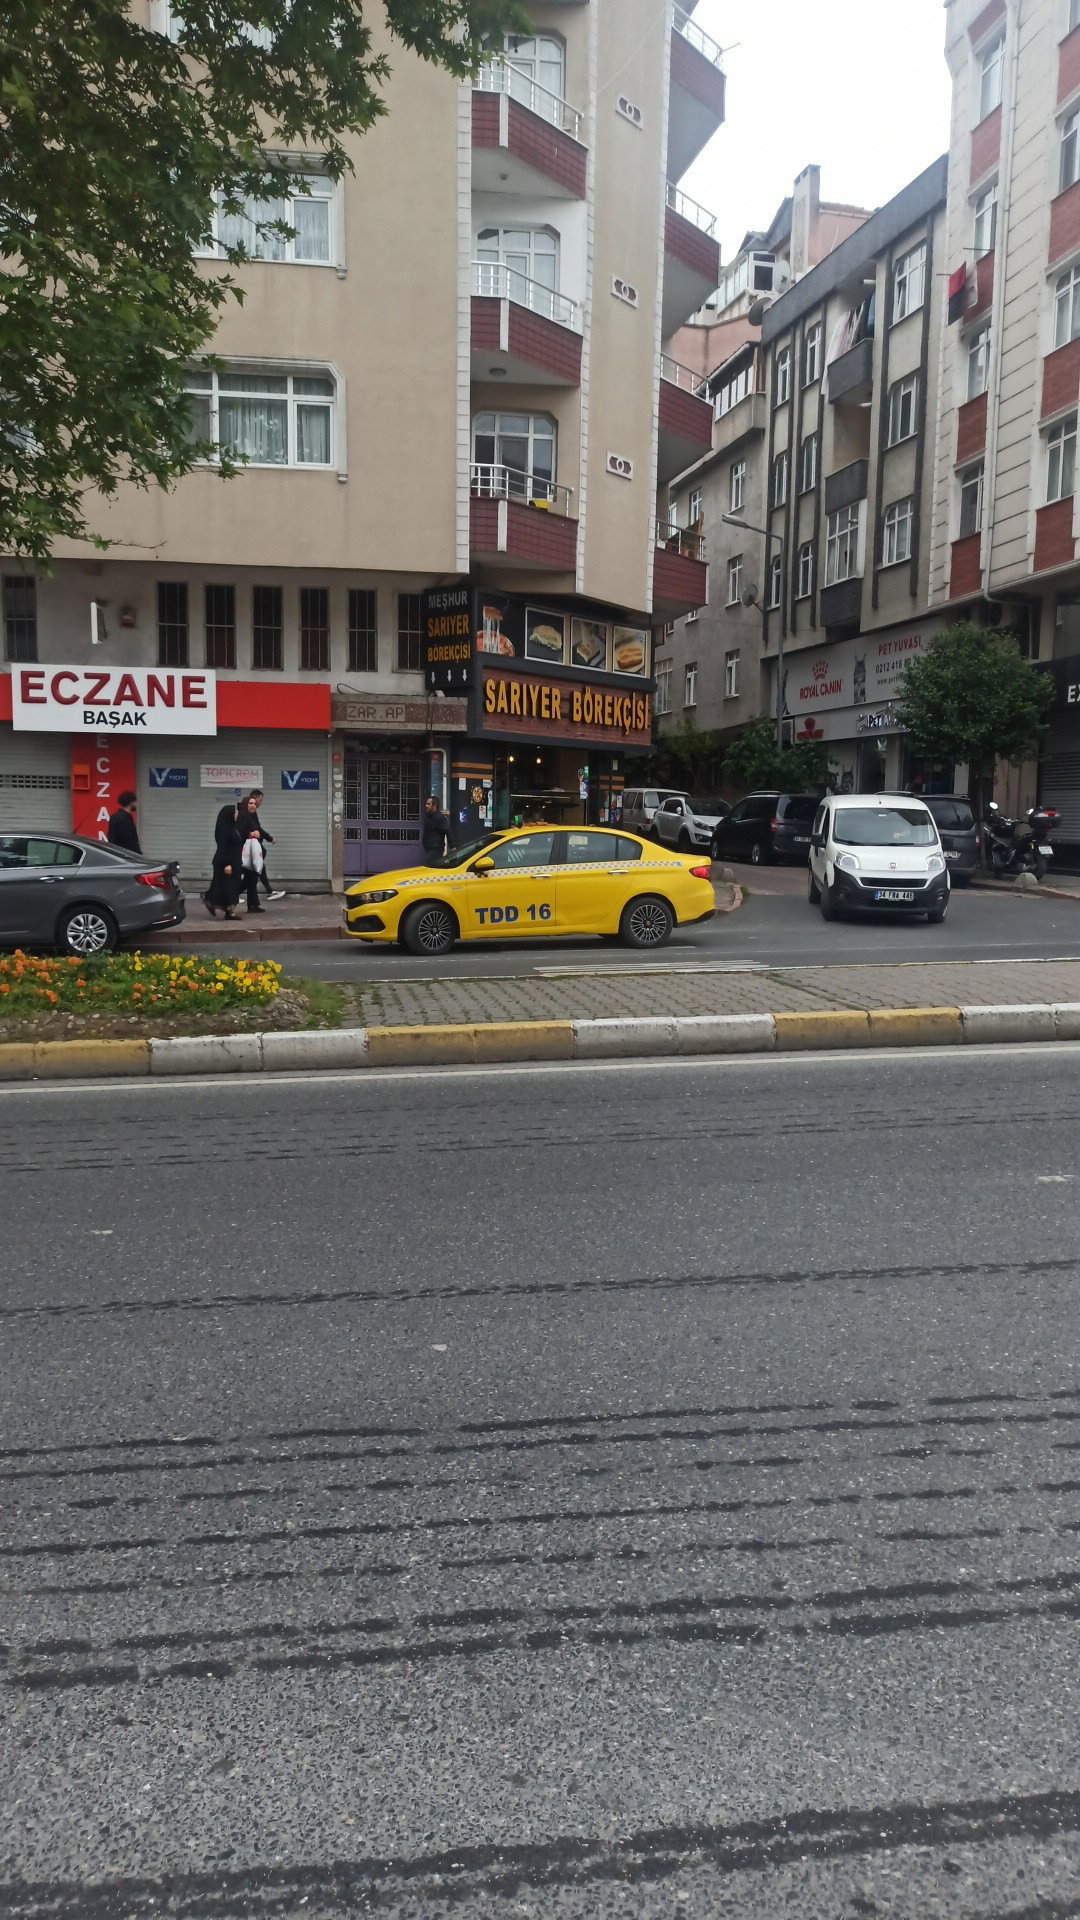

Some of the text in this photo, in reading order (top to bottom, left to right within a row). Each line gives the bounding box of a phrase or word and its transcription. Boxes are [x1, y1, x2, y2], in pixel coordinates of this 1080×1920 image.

[428, 591, 468, 611] MEŞHUR
[427, 614, 470, 637] SARIYER
[427, 641, 471, 663] BÖREKÇİSİ
[878, 642, 892, 656] PET
[875, 662, 890, 674] 0212
[20, 670, 208, 708] ECZANE
[800, 679, 842, 700] ROYAL CANIN
[485, 678, 649, 735] SARIYER BÖREKÇİSİ
[83, 710, 147, 728] BAŞAK
[475, 903, 551, 924] TDD 16
